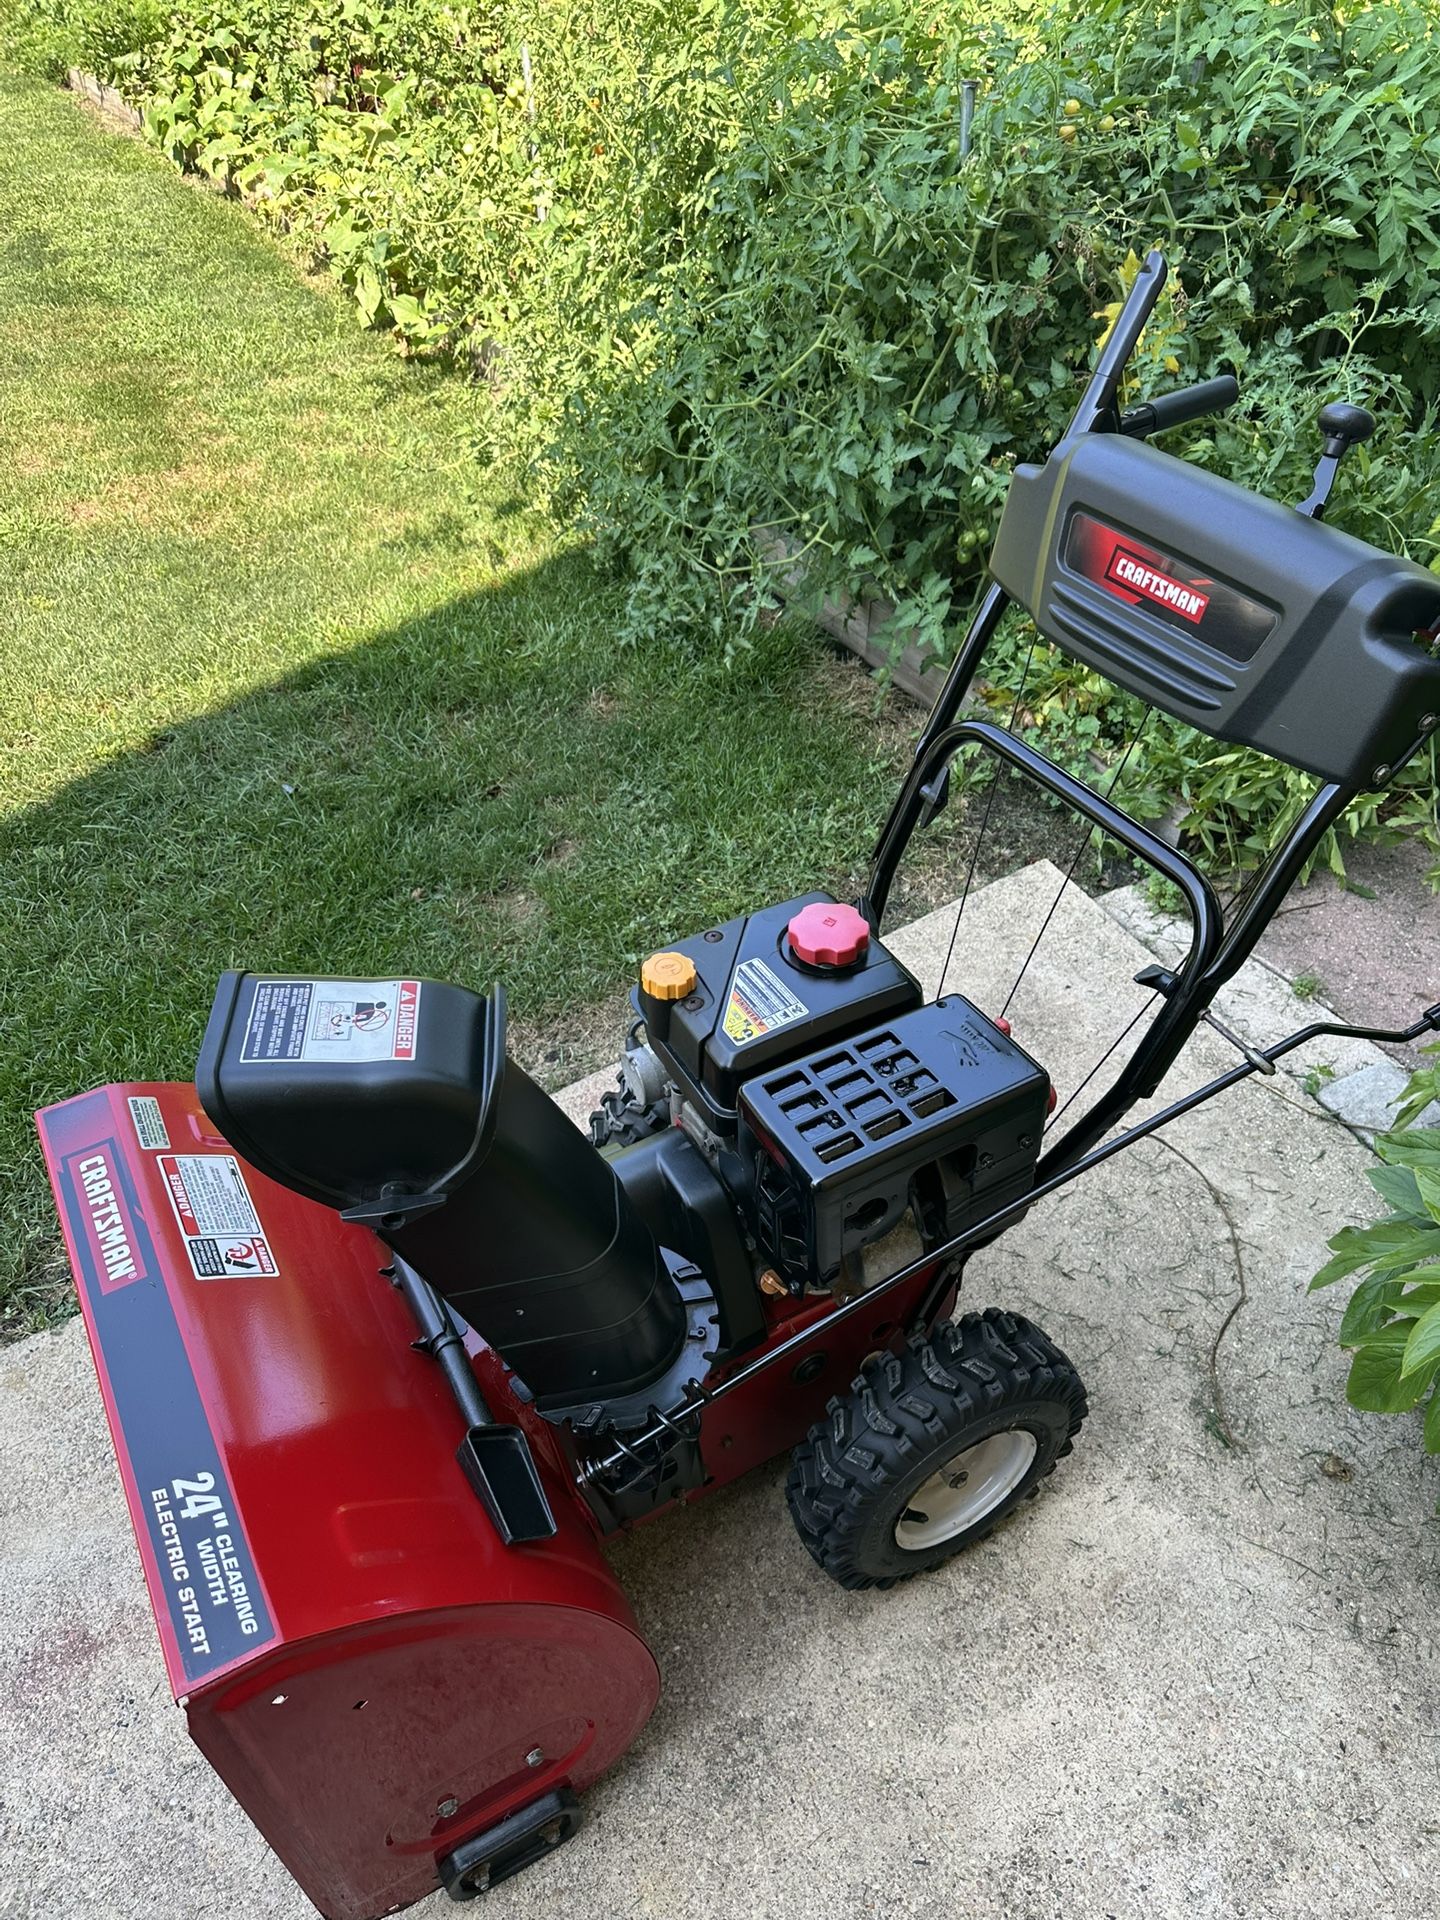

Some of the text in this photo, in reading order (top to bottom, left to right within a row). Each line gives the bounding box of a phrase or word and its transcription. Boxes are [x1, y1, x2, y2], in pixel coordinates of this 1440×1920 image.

[1116, 558, 1201, 615] CRAFTSMAN
[397, 1003, 415, 1049] DANGER
[79, 1155, 135, 1281] CRAFTSMAN
[169, 1174, 190, 1209] DANGER
[257, 1246, 273, 1273] DANGER
[151, 1488, 211, 1655] ELECTRIC START
[196, 1537, 229, 1606] WIDTH
[215, 1534, 259, 1635] CLEARING
